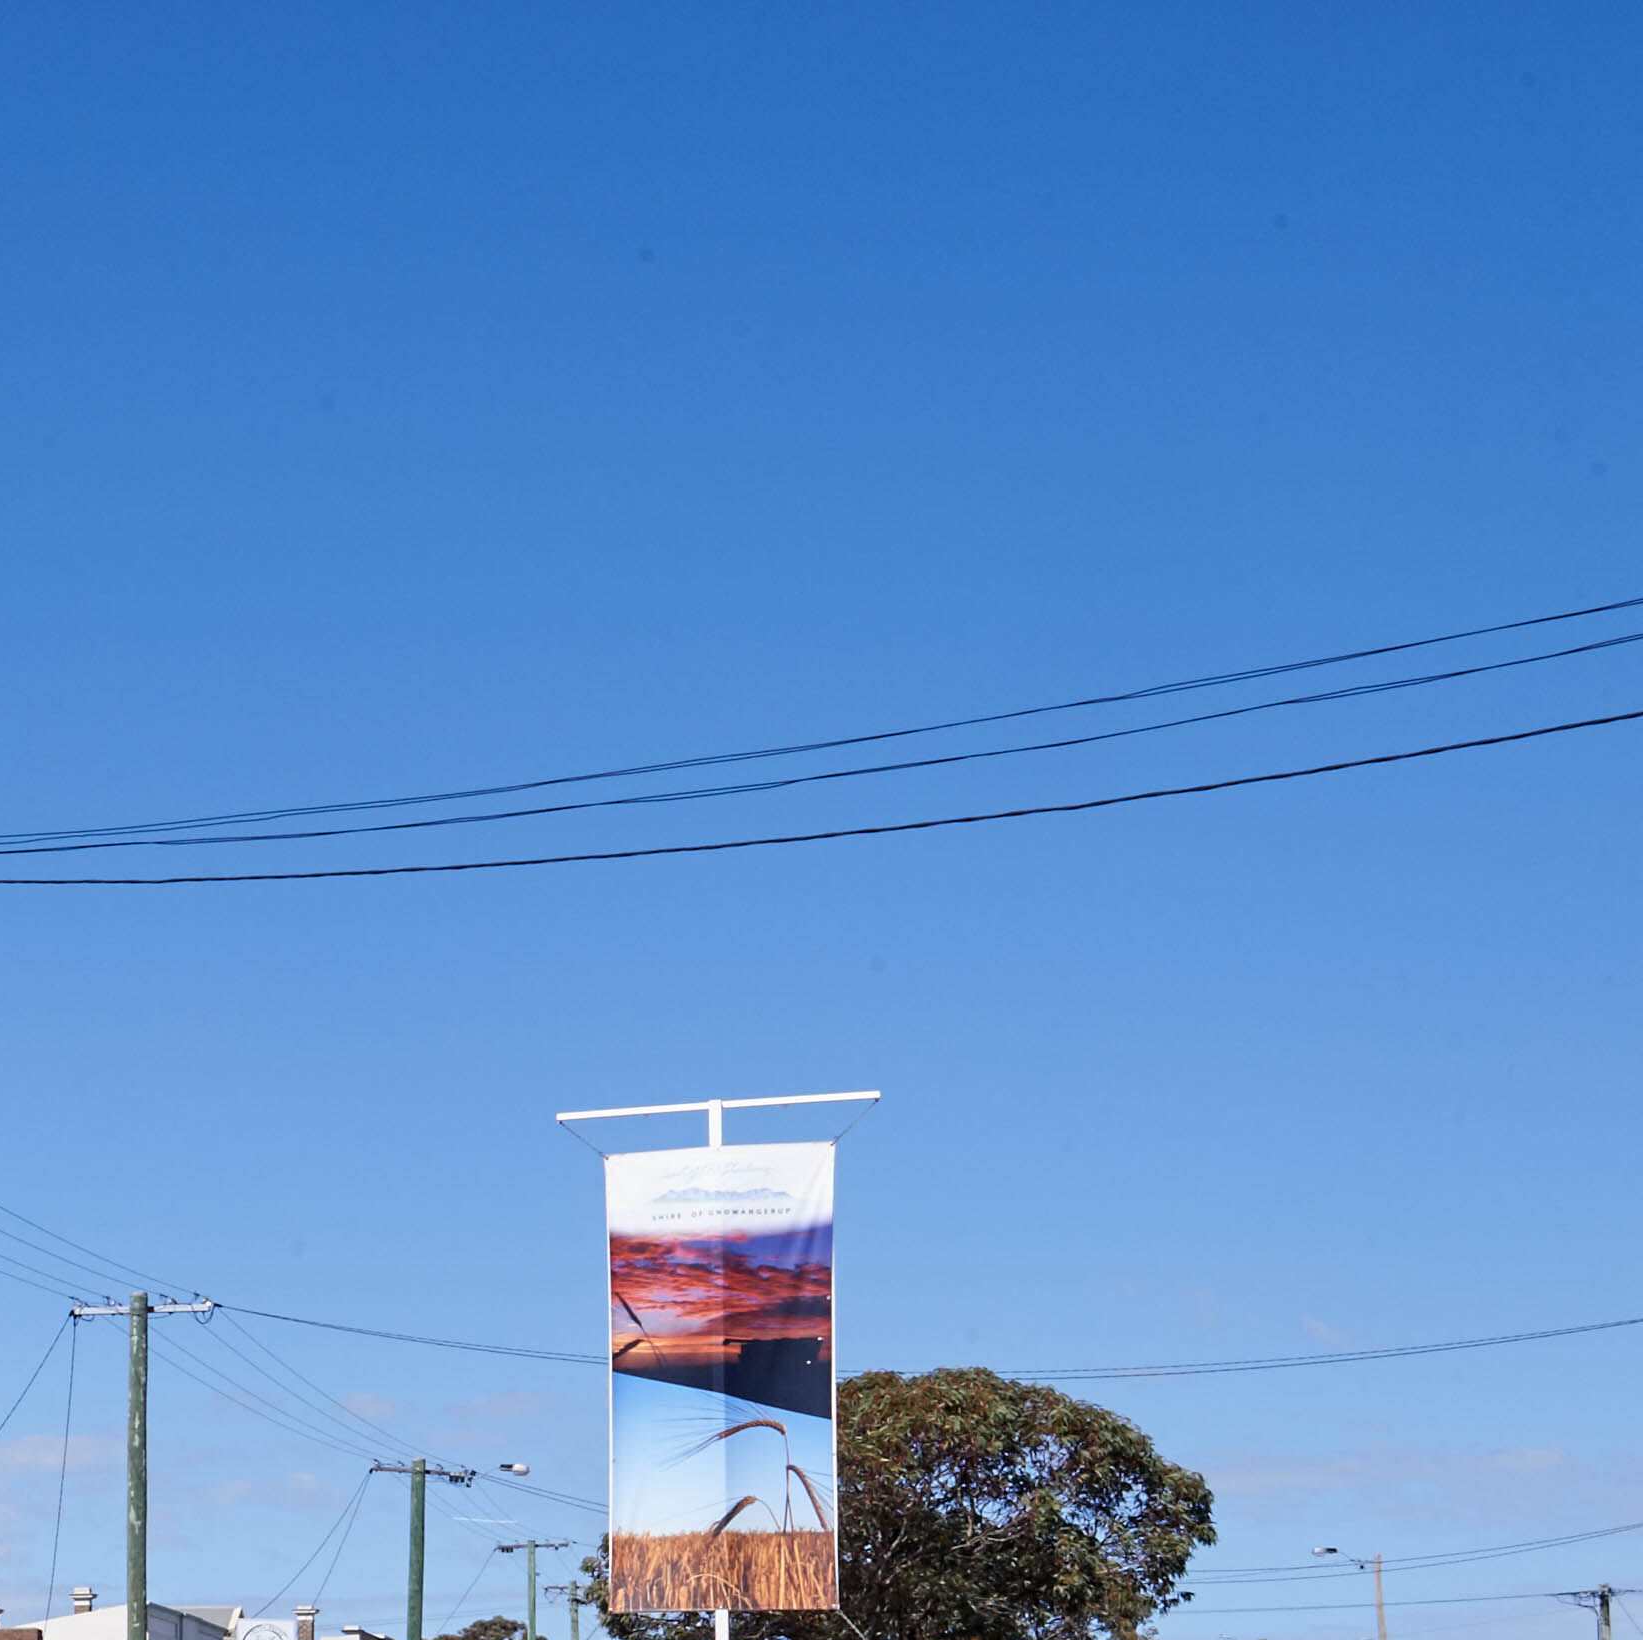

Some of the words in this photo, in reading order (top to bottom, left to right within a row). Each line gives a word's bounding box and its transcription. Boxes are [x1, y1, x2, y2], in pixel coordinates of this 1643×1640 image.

[652, 1213, 681, 1221] SHIRE
[691, 1210, 703, 1218] OF
[708, 1207, 791, 1217] GNOWANGERUP
